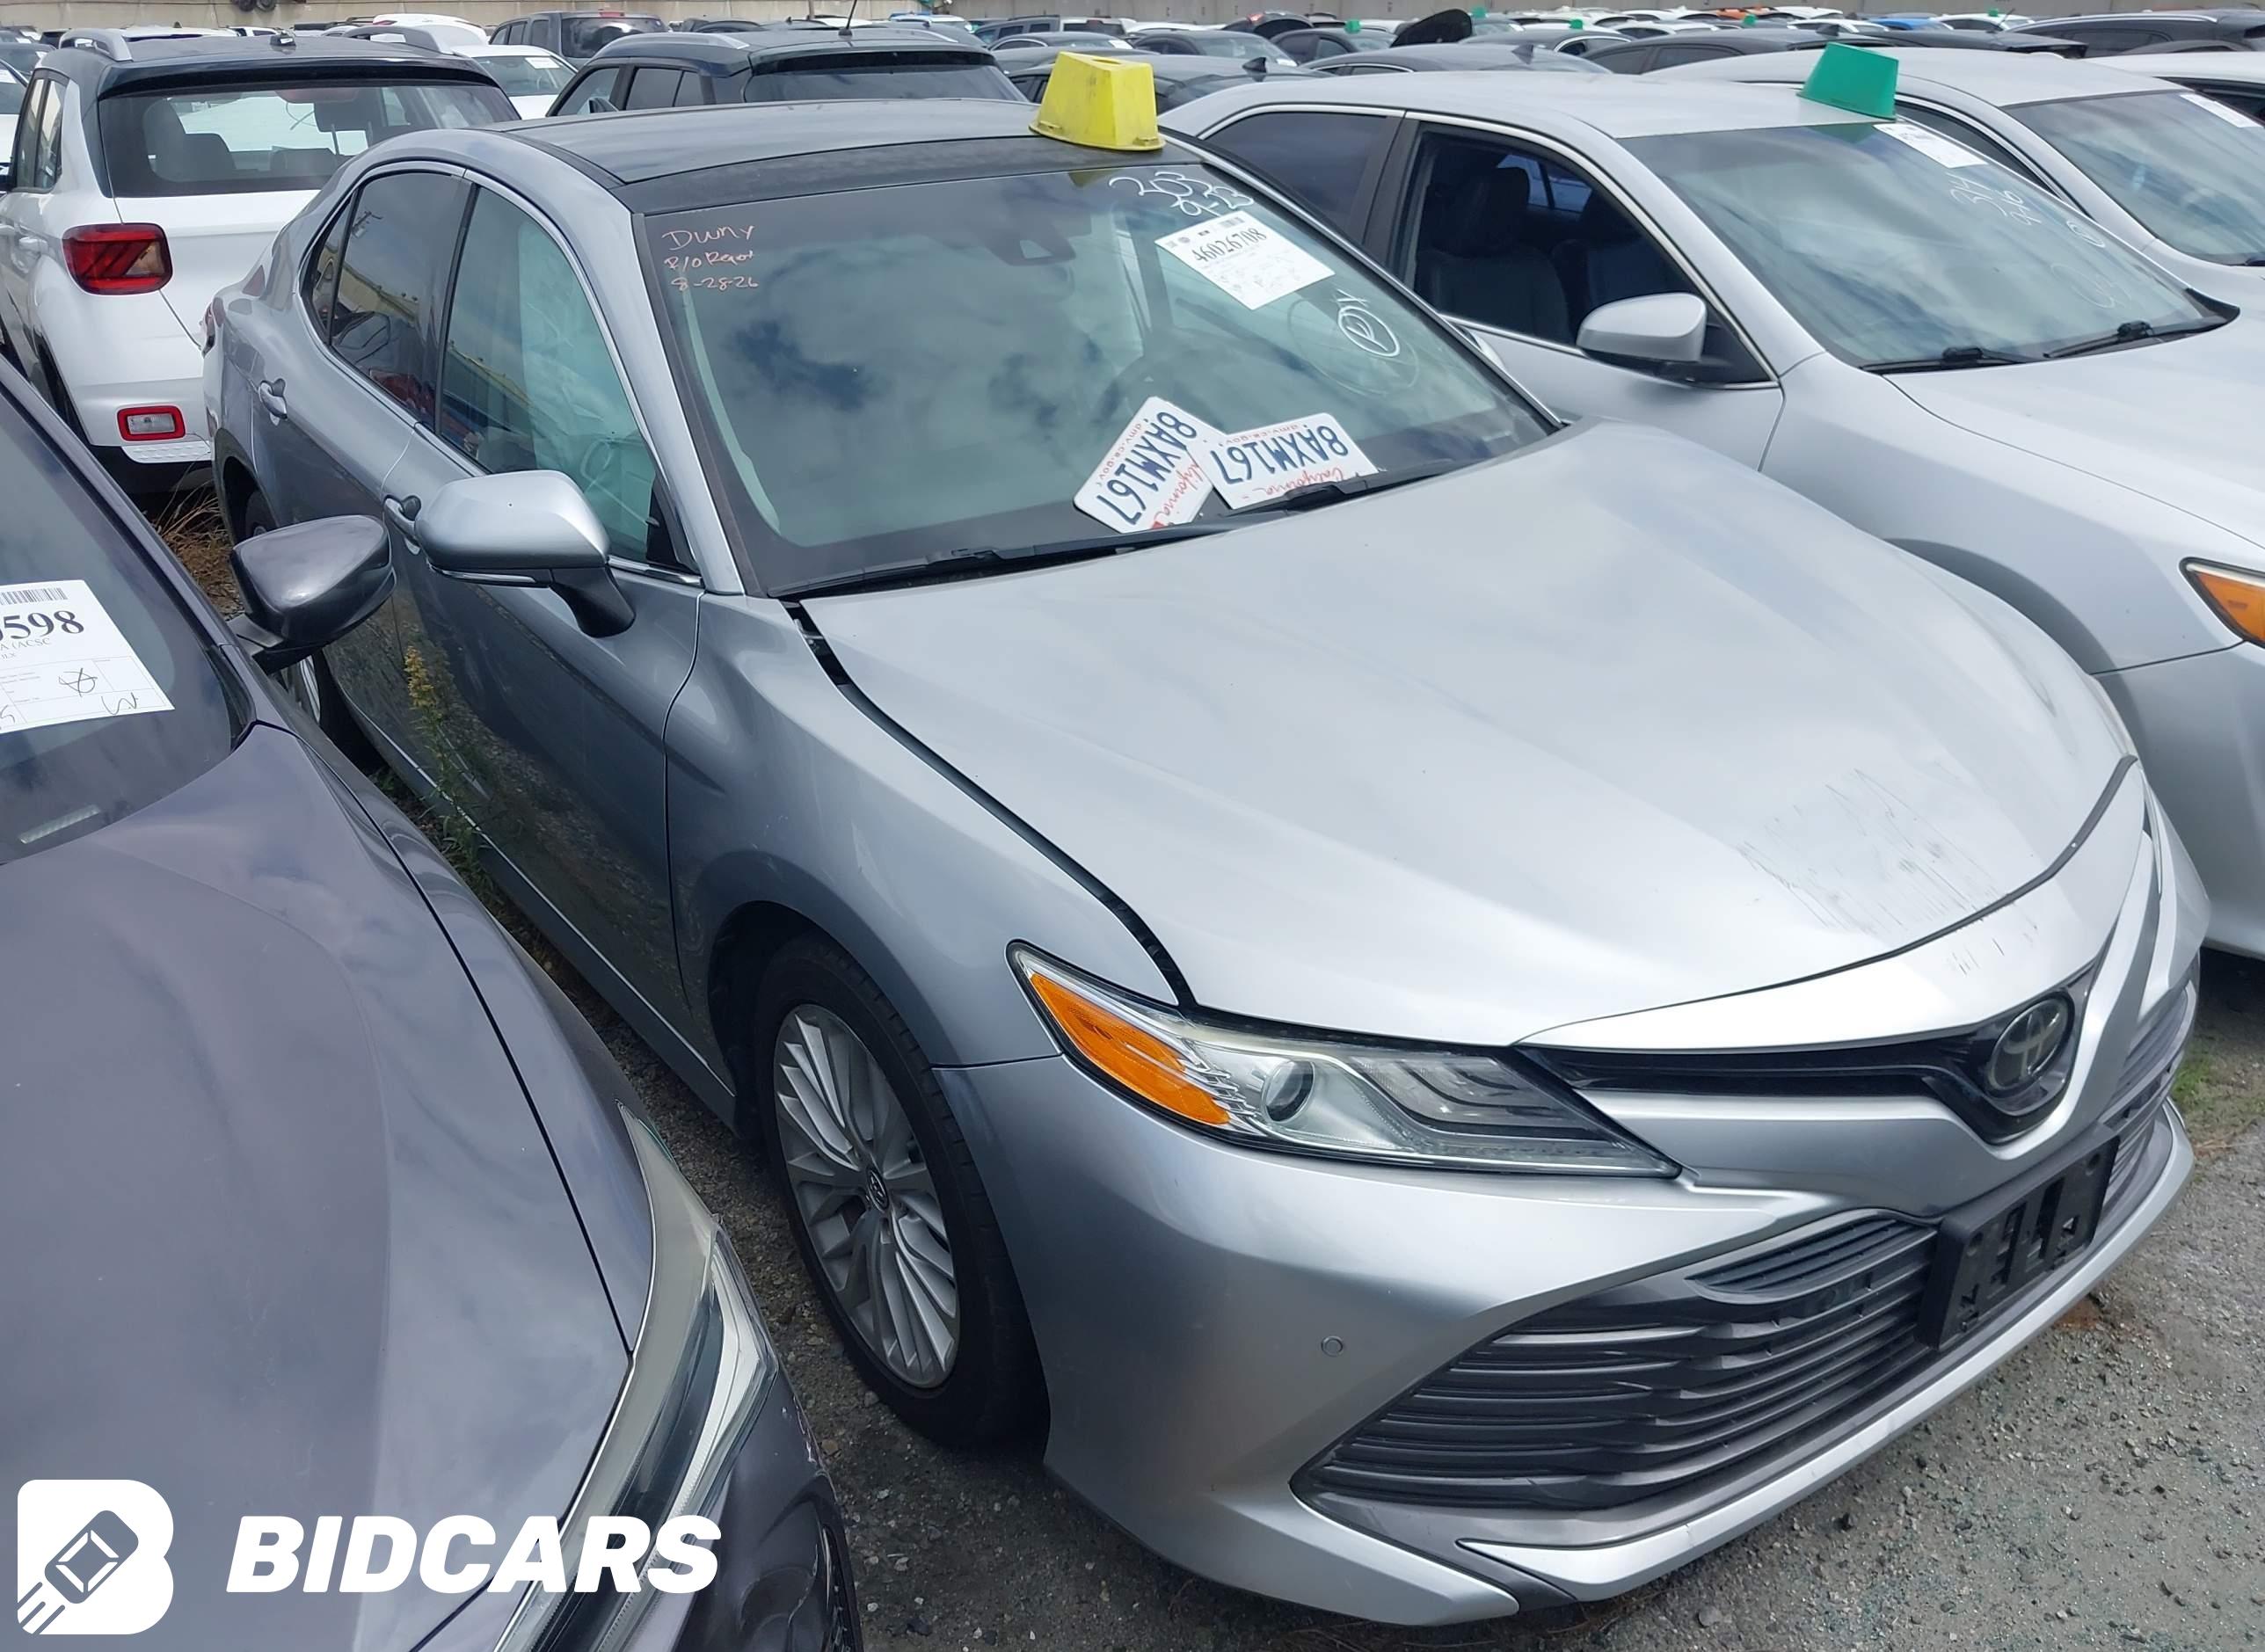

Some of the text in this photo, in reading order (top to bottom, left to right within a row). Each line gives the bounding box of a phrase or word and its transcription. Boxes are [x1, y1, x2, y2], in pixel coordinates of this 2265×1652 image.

[1096, 411, 1198, 526] 8AXM167
[1210, 426, 1349, 485] 8AXM167
[0, 610, 84, 641] 598
